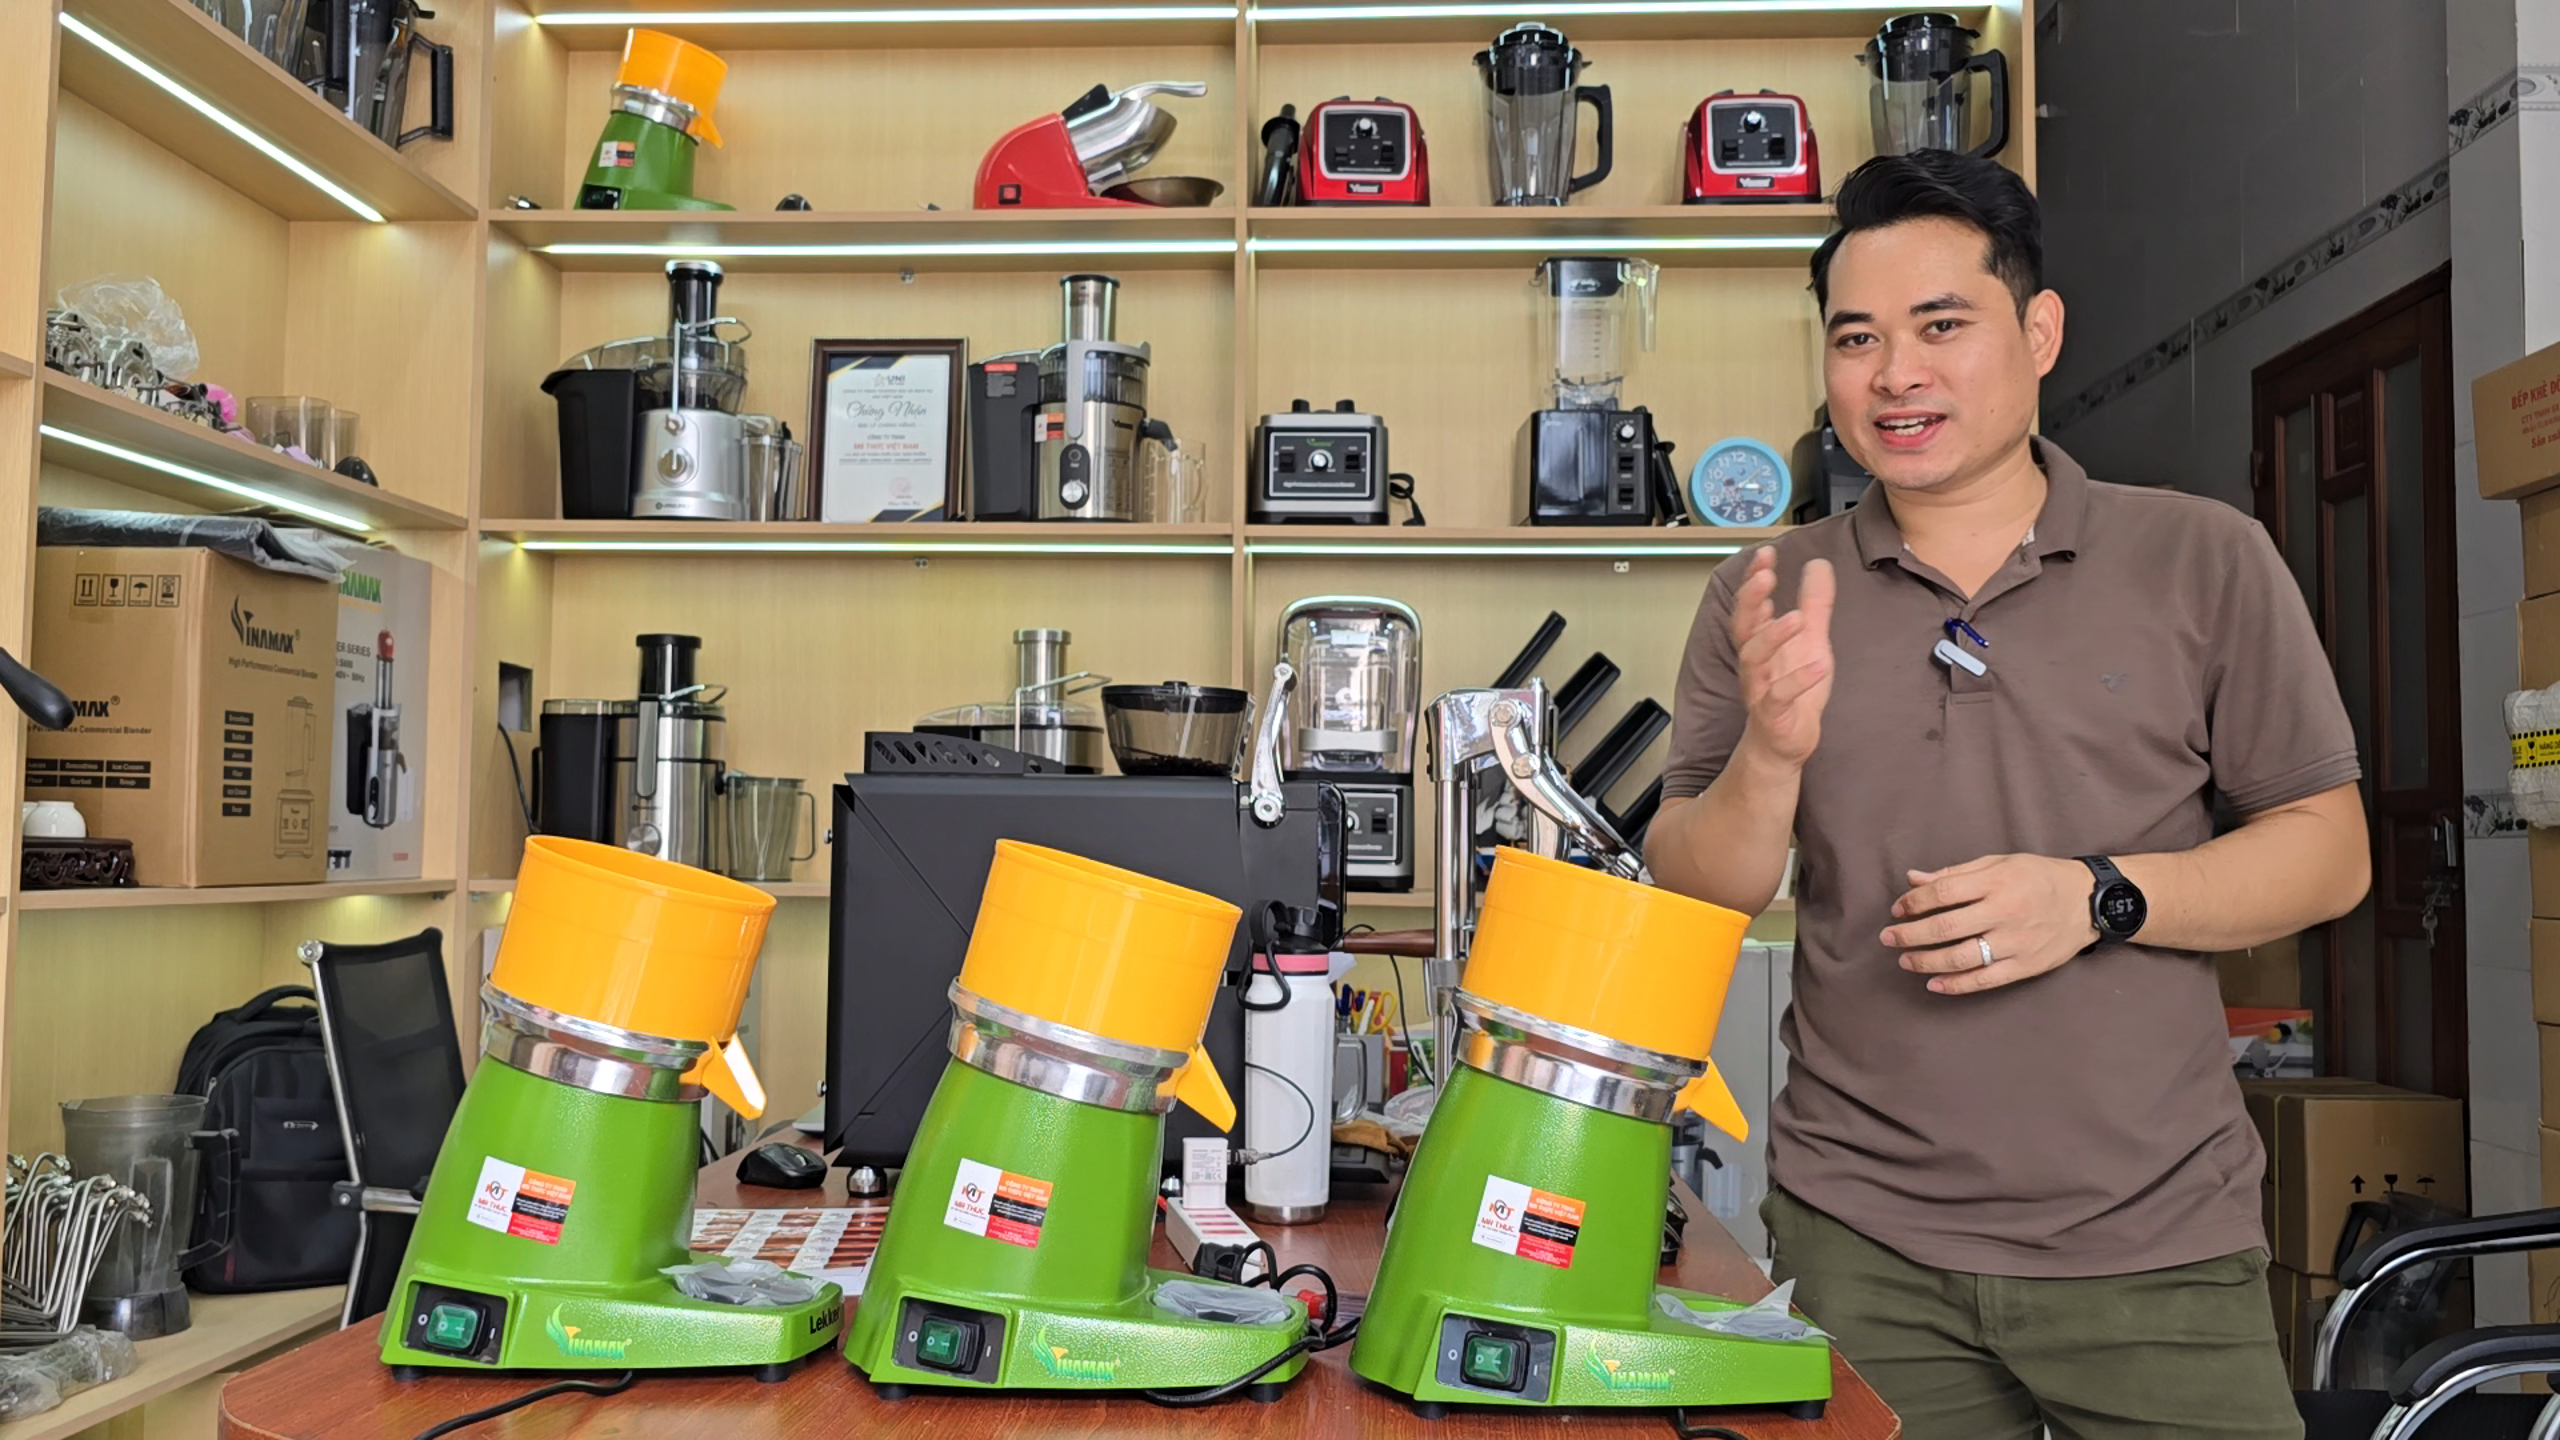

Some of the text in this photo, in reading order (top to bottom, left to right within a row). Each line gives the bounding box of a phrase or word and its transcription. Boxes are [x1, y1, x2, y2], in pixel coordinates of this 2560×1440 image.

[1731, 451, 1746, 462] 12
[1751, 455, 1758, 466] 1
[1717, 457, 1729, 468] 11
[1707, 468, 1723, 480] 10
[1761, 465, 1771, 476] 2
[1704, 481, 1715, 492] 9
[1767, 480, 1777, 492] 3
[1709, 495, 1720, 507] 8
[1763, 495, 1773, 506] 4
[1722, 506, 1732, 517] 7
[1736, 510, 1747, 522] 6
[1753, 506, 1763, 518] 5
[347, 643, 371, 658] SERIES
[80, 725, 122, 733] Commercial
[124, 726, 152, 734] Blender
